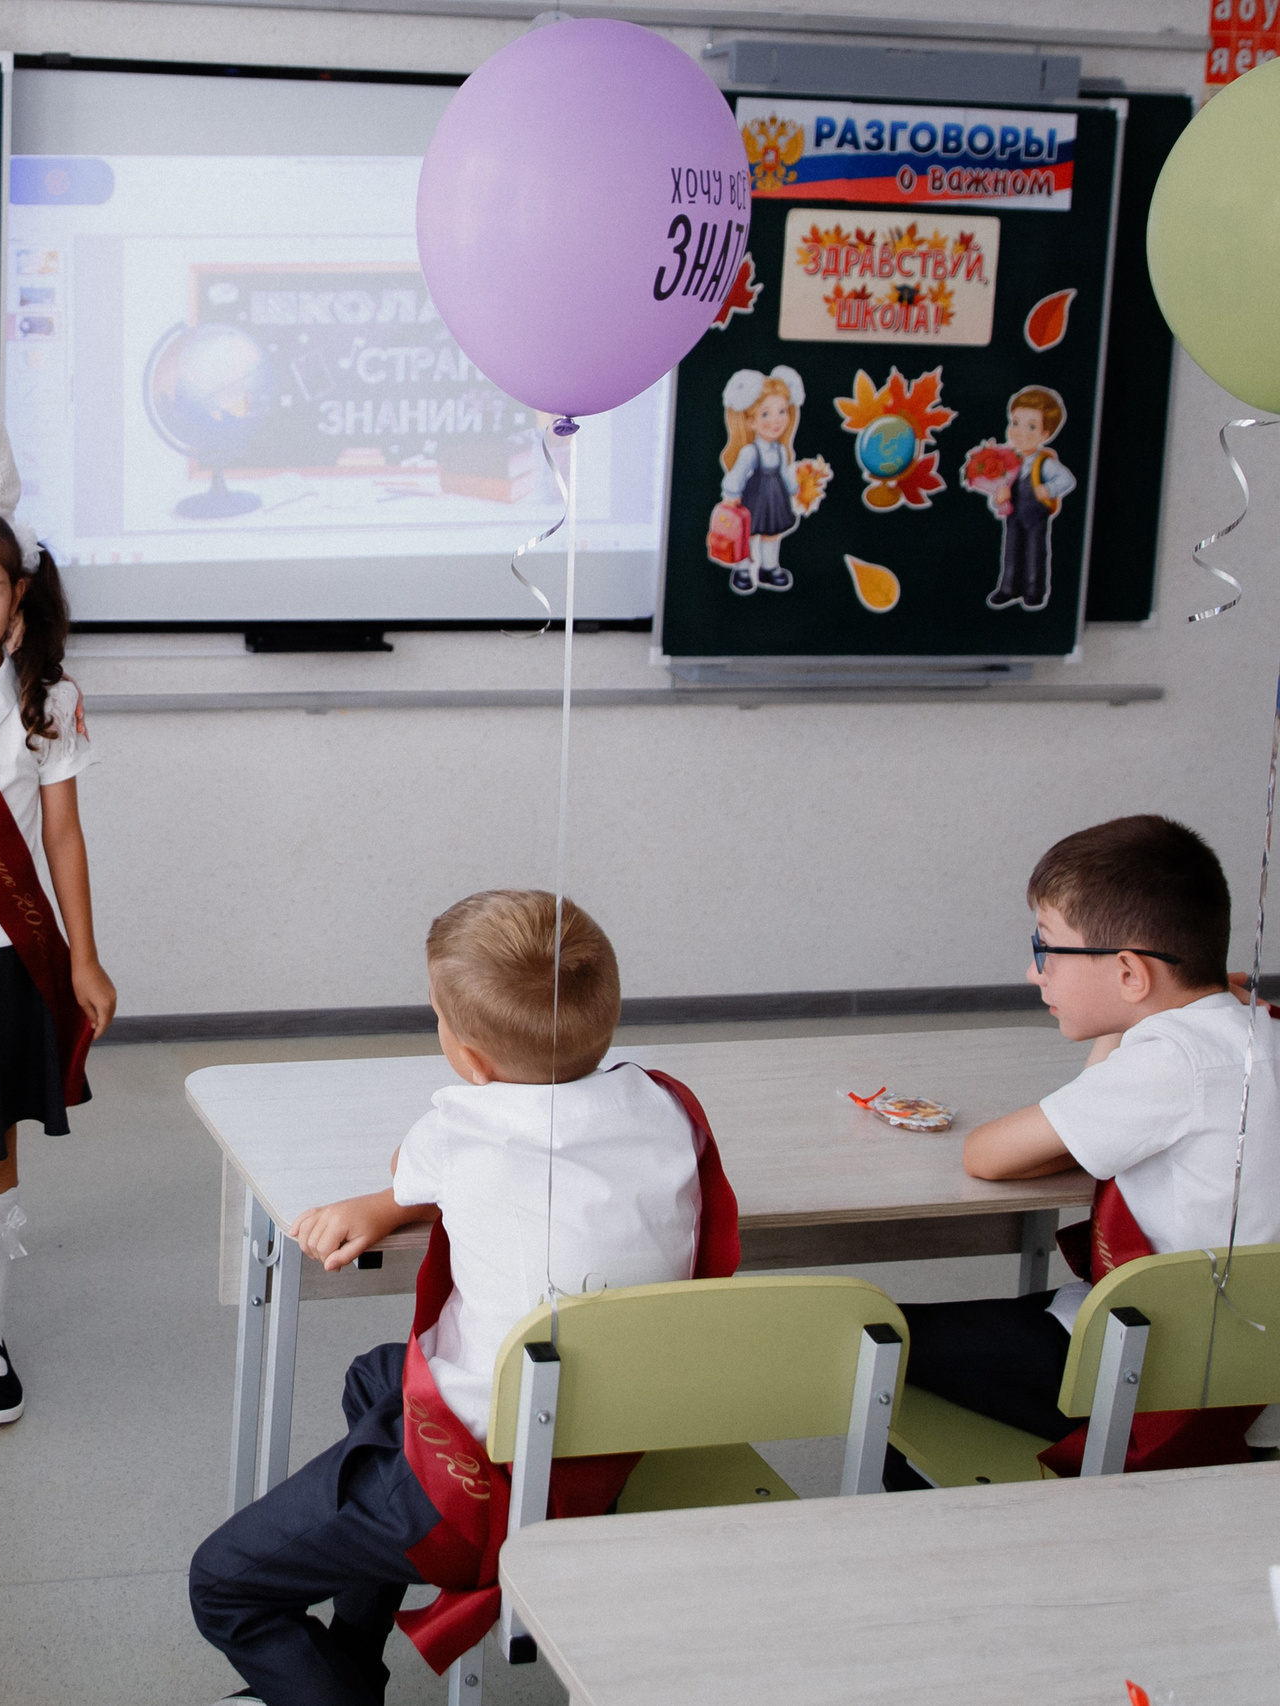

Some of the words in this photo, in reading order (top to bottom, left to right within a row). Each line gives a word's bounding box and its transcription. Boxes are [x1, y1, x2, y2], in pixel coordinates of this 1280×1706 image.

[813, 114, 1059, 161] РАЗГОВОРЫ
[671, 167, 723, 205] ХОЧУ
[803, 240, 988, 286] ЗДРАВСТВУЙ,
[835, 298, 945, 333] ШКОЛА!
